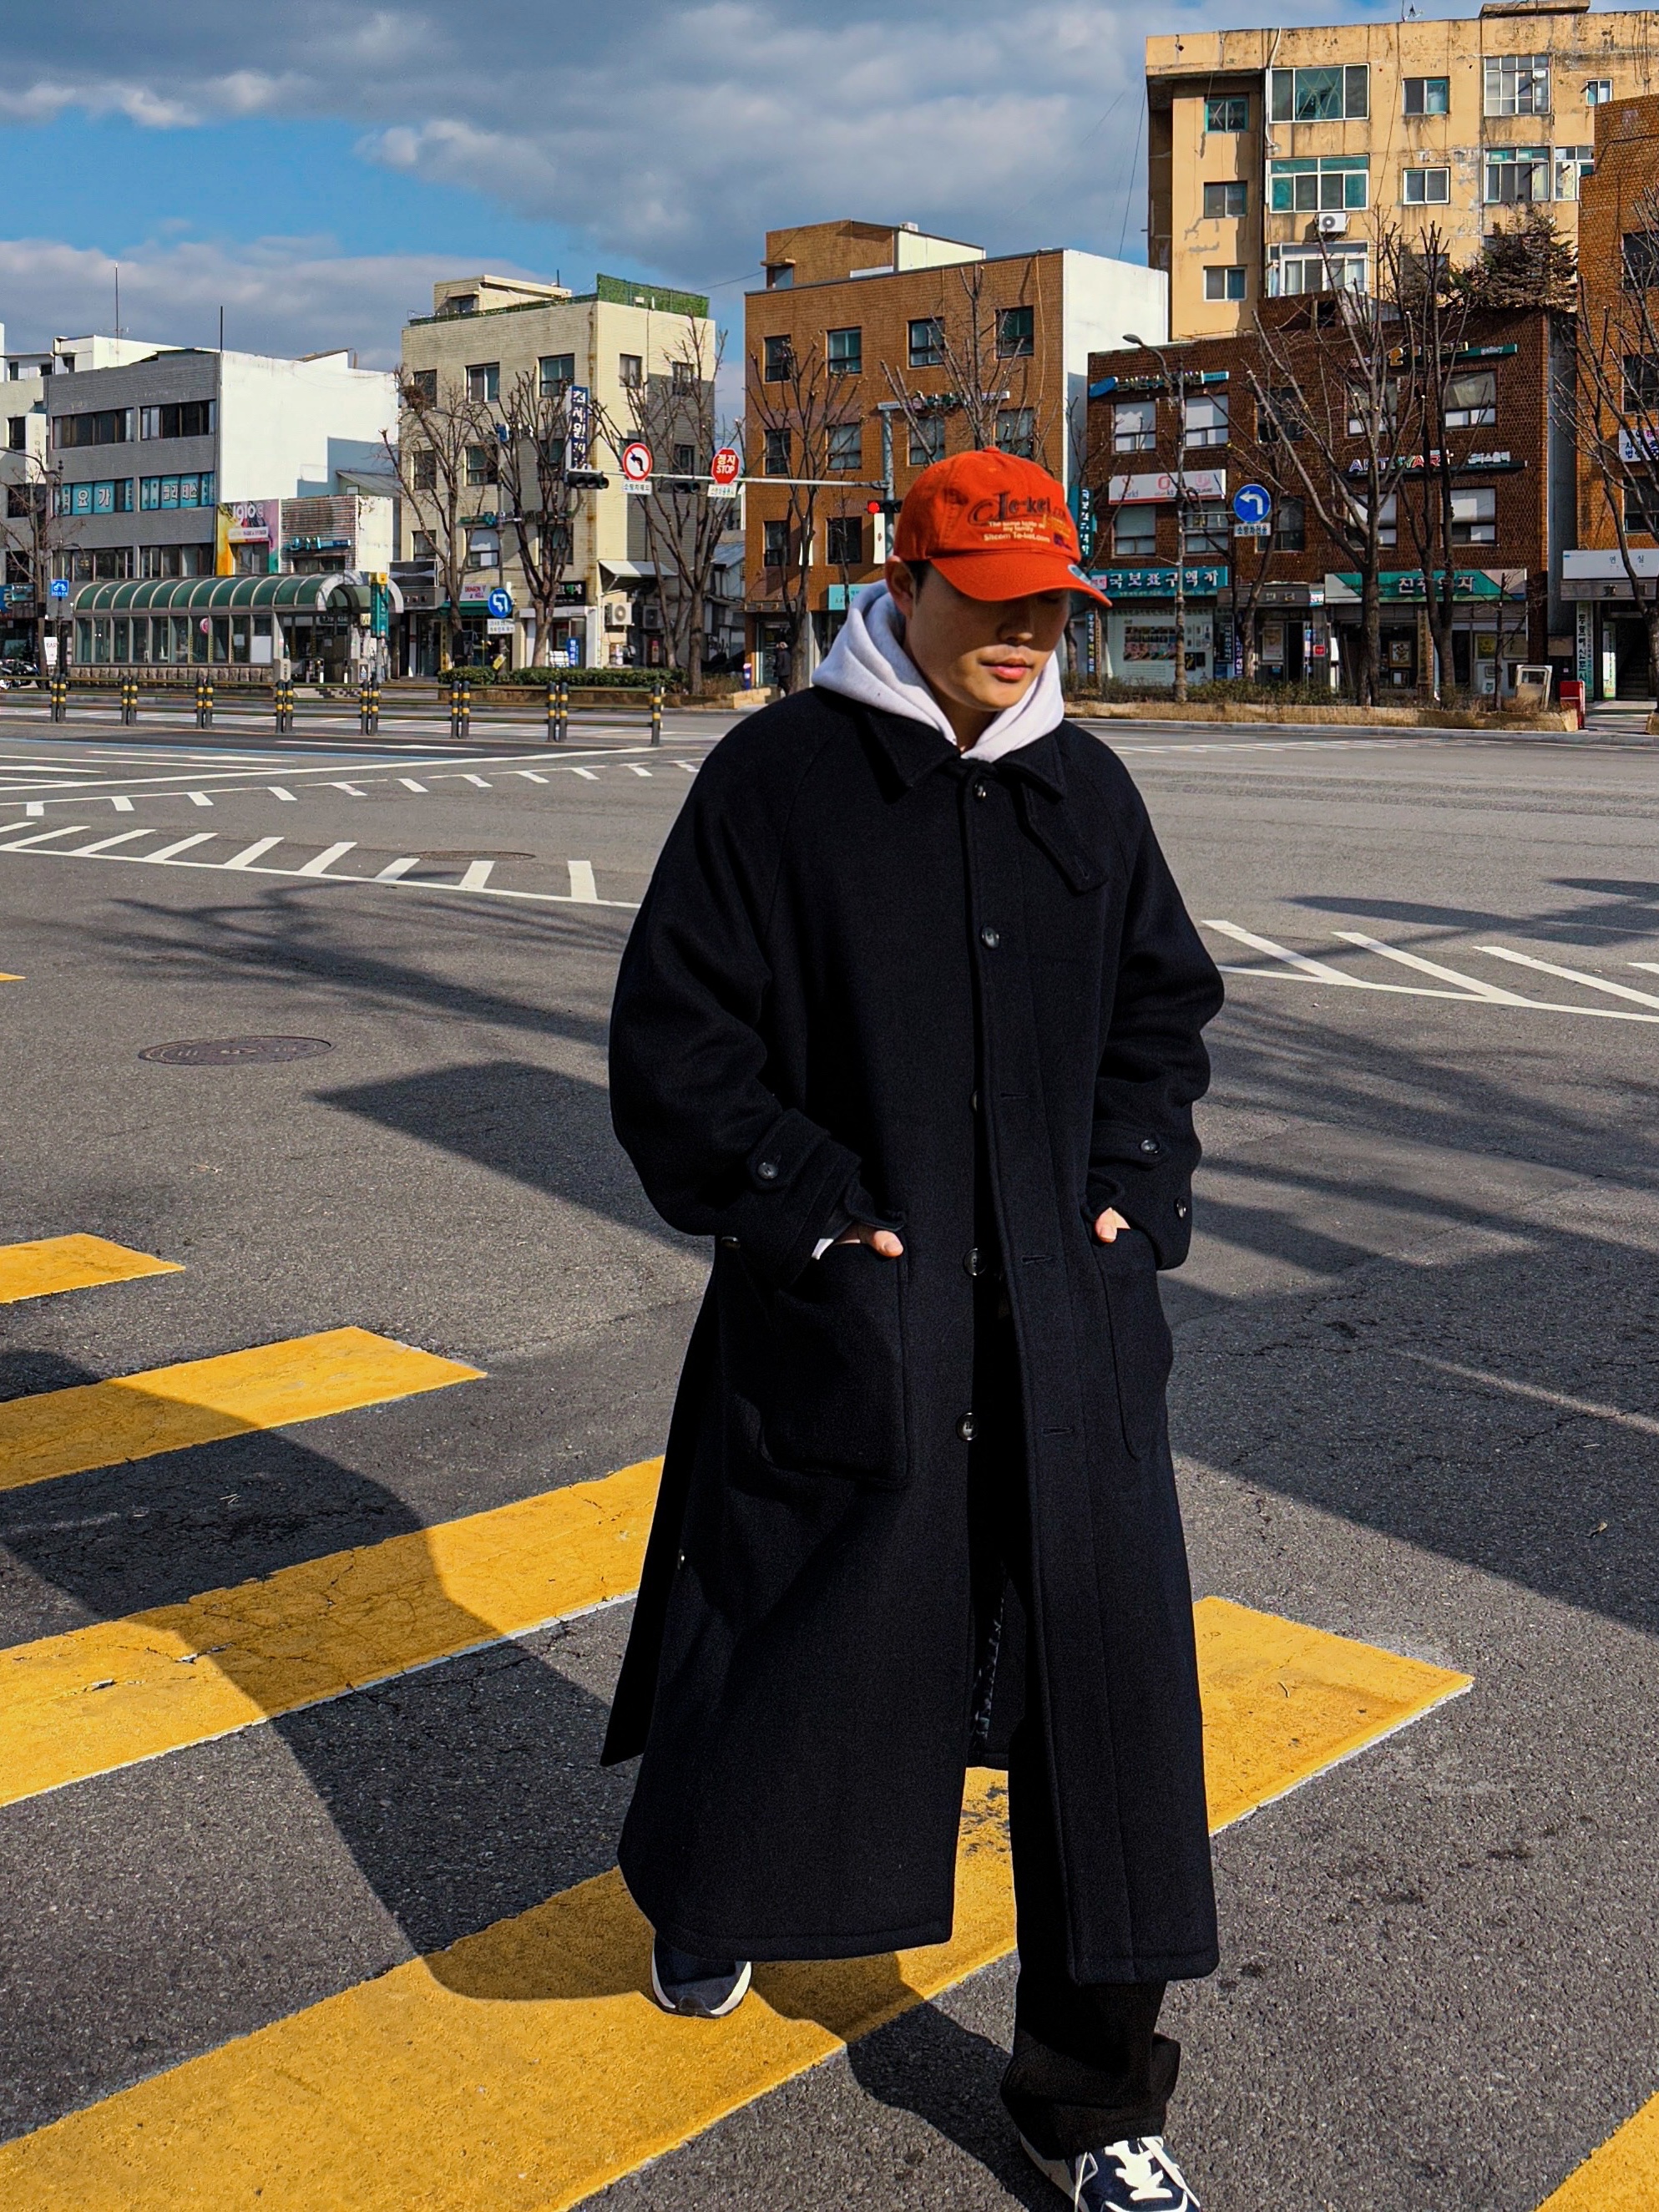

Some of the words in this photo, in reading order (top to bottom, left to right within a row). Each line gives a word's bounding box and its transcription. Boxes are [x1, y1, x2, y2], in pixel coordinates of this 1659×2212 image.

[717, 453, 736, 464] 정지
[716, 465, 735, 474] STOP
[77, 488, 110, 507] 요가
